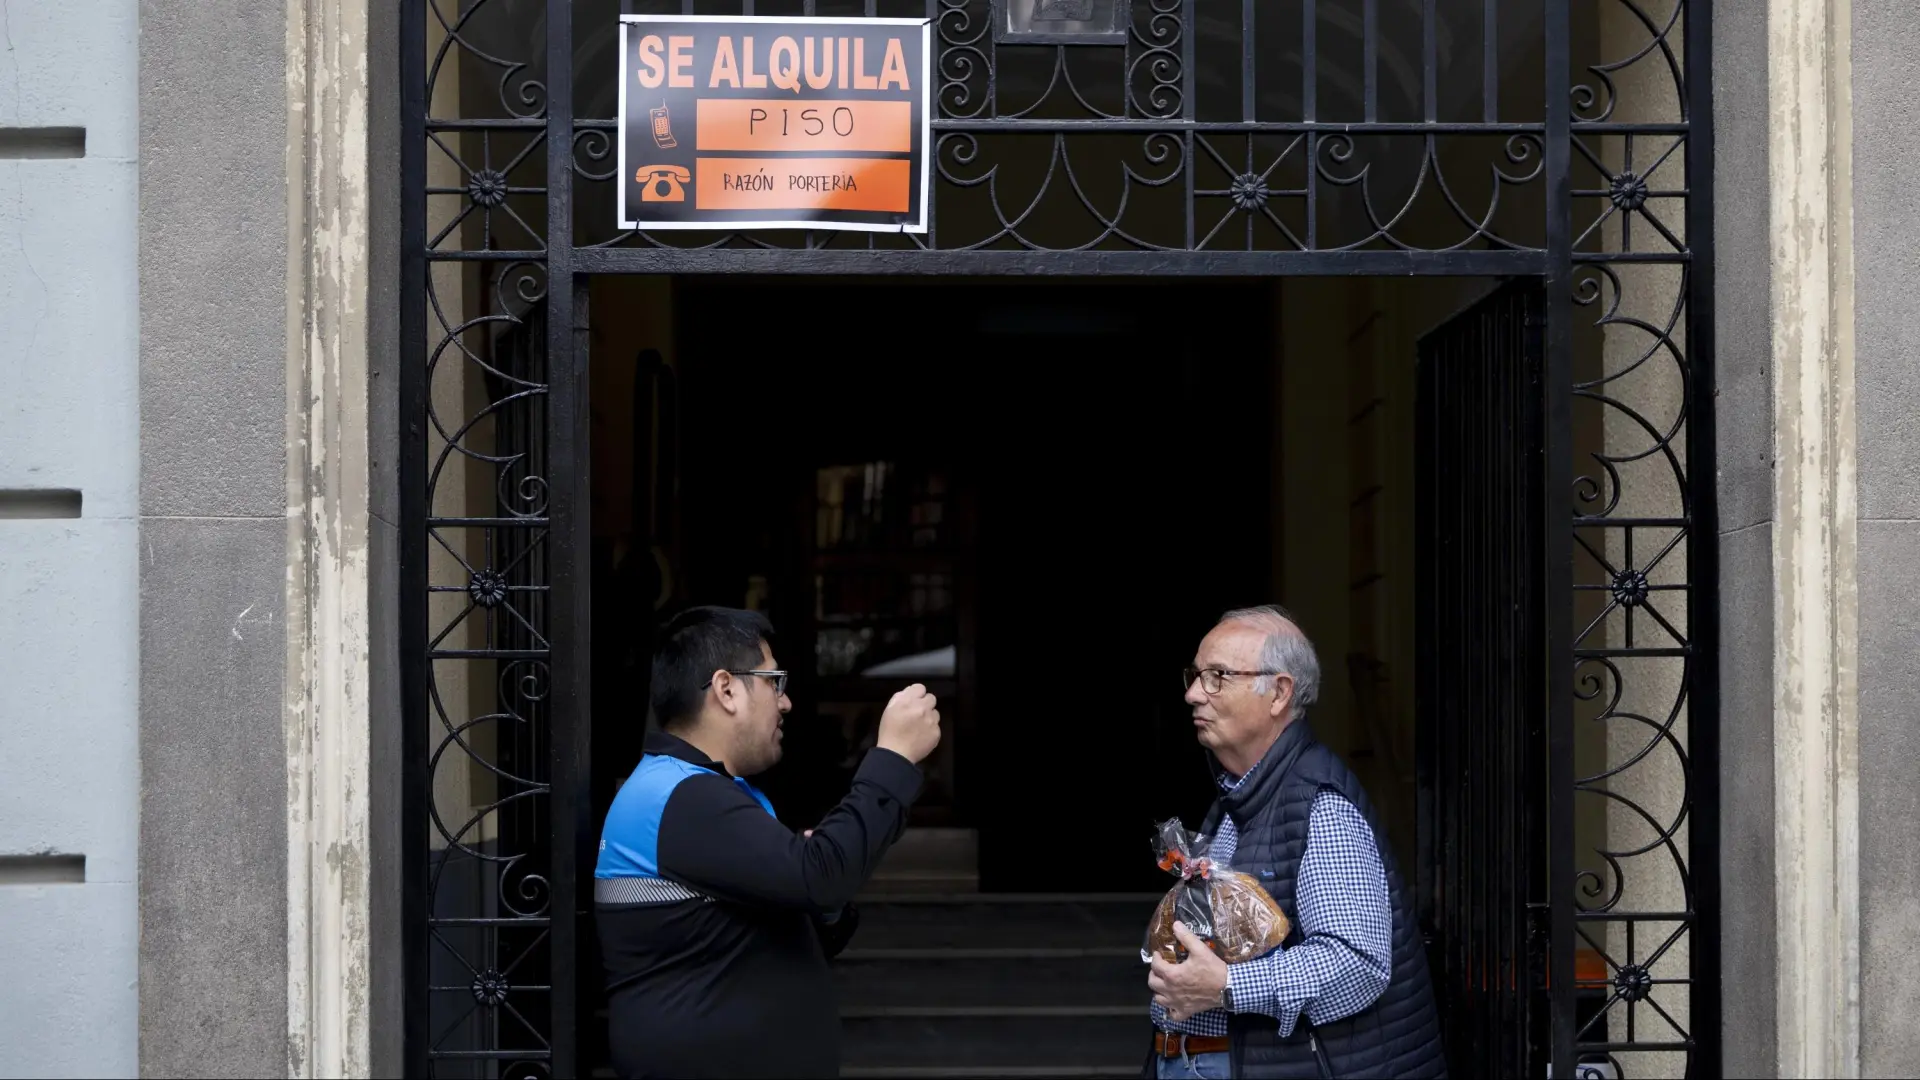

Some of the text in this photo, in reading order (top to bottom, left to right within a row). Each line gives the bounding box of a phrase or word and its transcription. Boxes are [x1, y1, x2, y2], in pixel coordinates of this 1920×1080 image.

[637, 34, 911, 94] SE ALQUILA
[749, 106, 855, 137] PISO
[723, 167, 774, 192] RAZÓN
